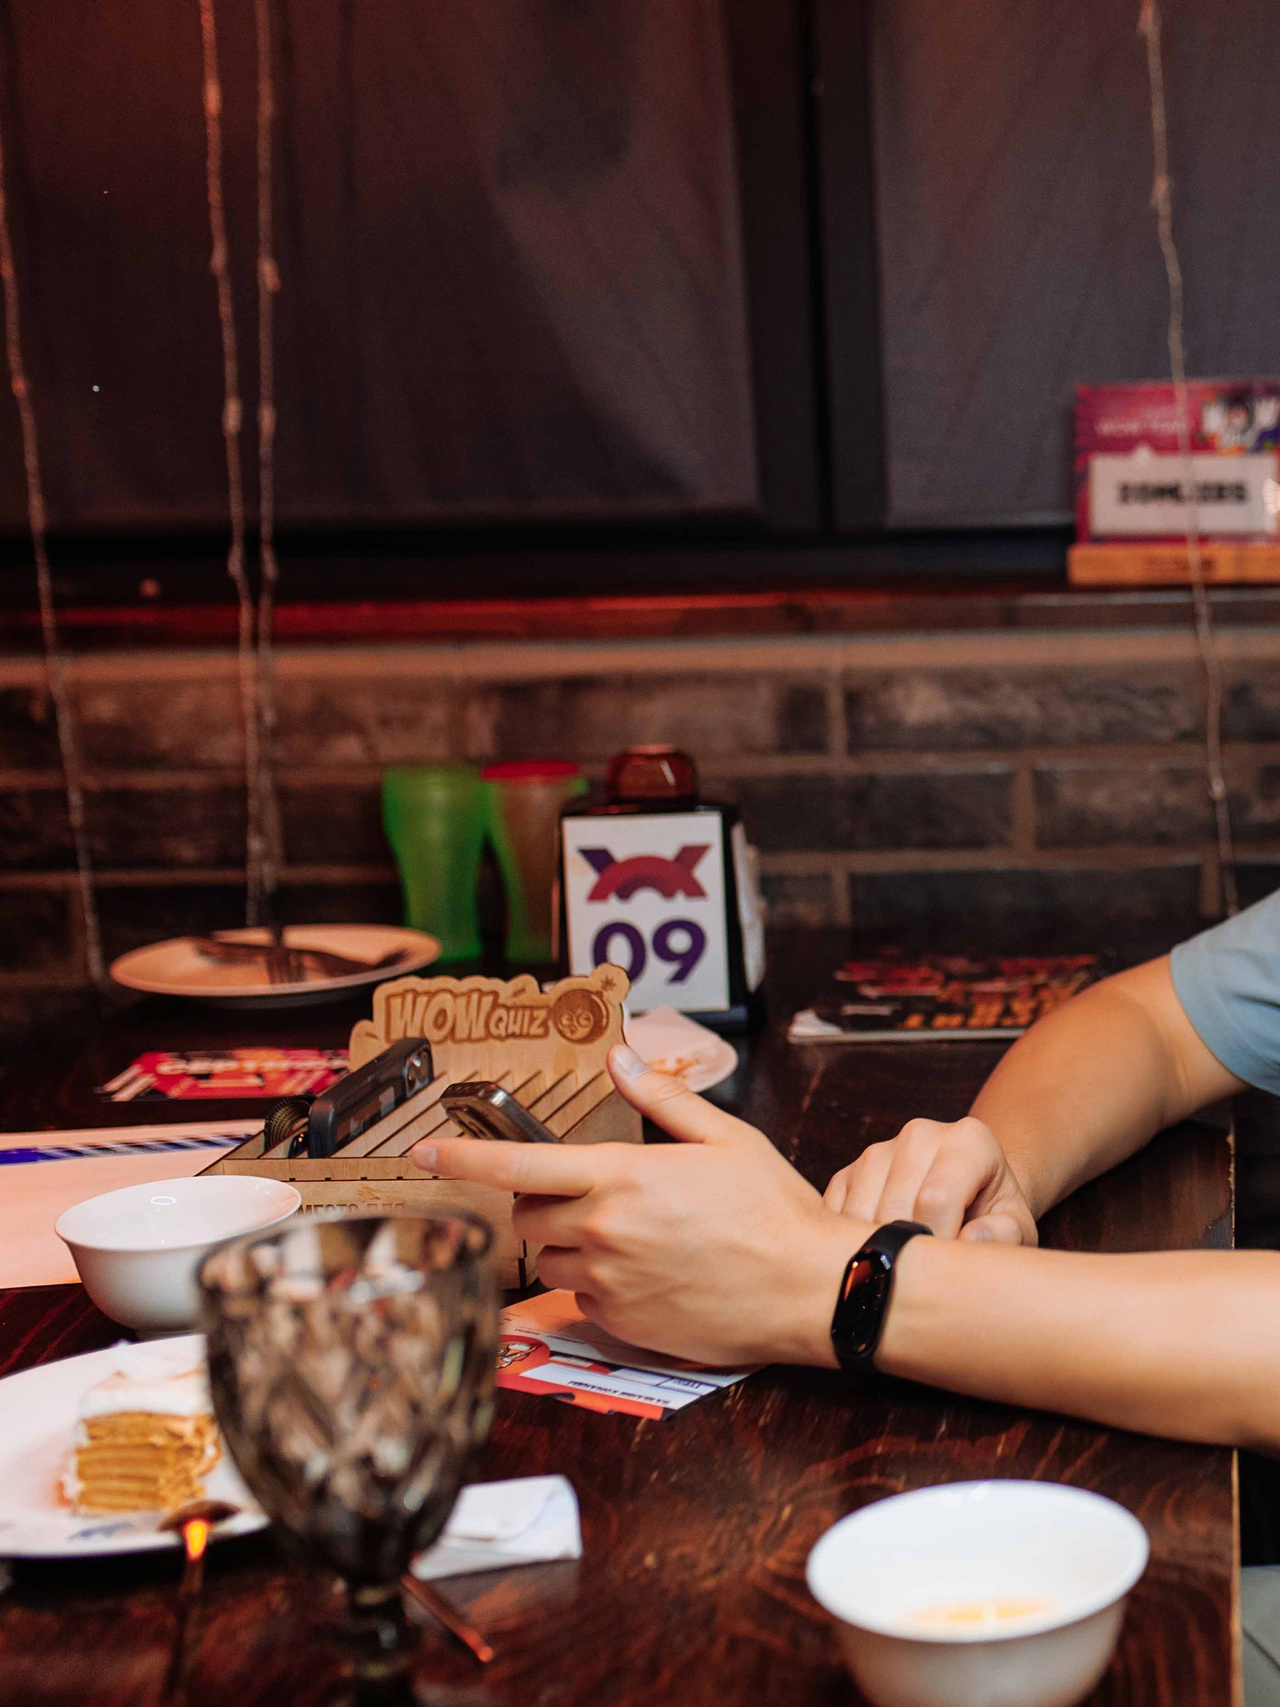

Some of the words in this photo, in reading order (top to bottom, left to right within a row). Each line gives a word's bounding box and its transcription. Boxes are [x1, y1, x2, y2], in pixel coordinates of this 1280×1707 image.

[592, 919, 706, 984] 09
[387, 990, 494, 1043] WOW
[489, 1005, 549, 1038] QUIZ
